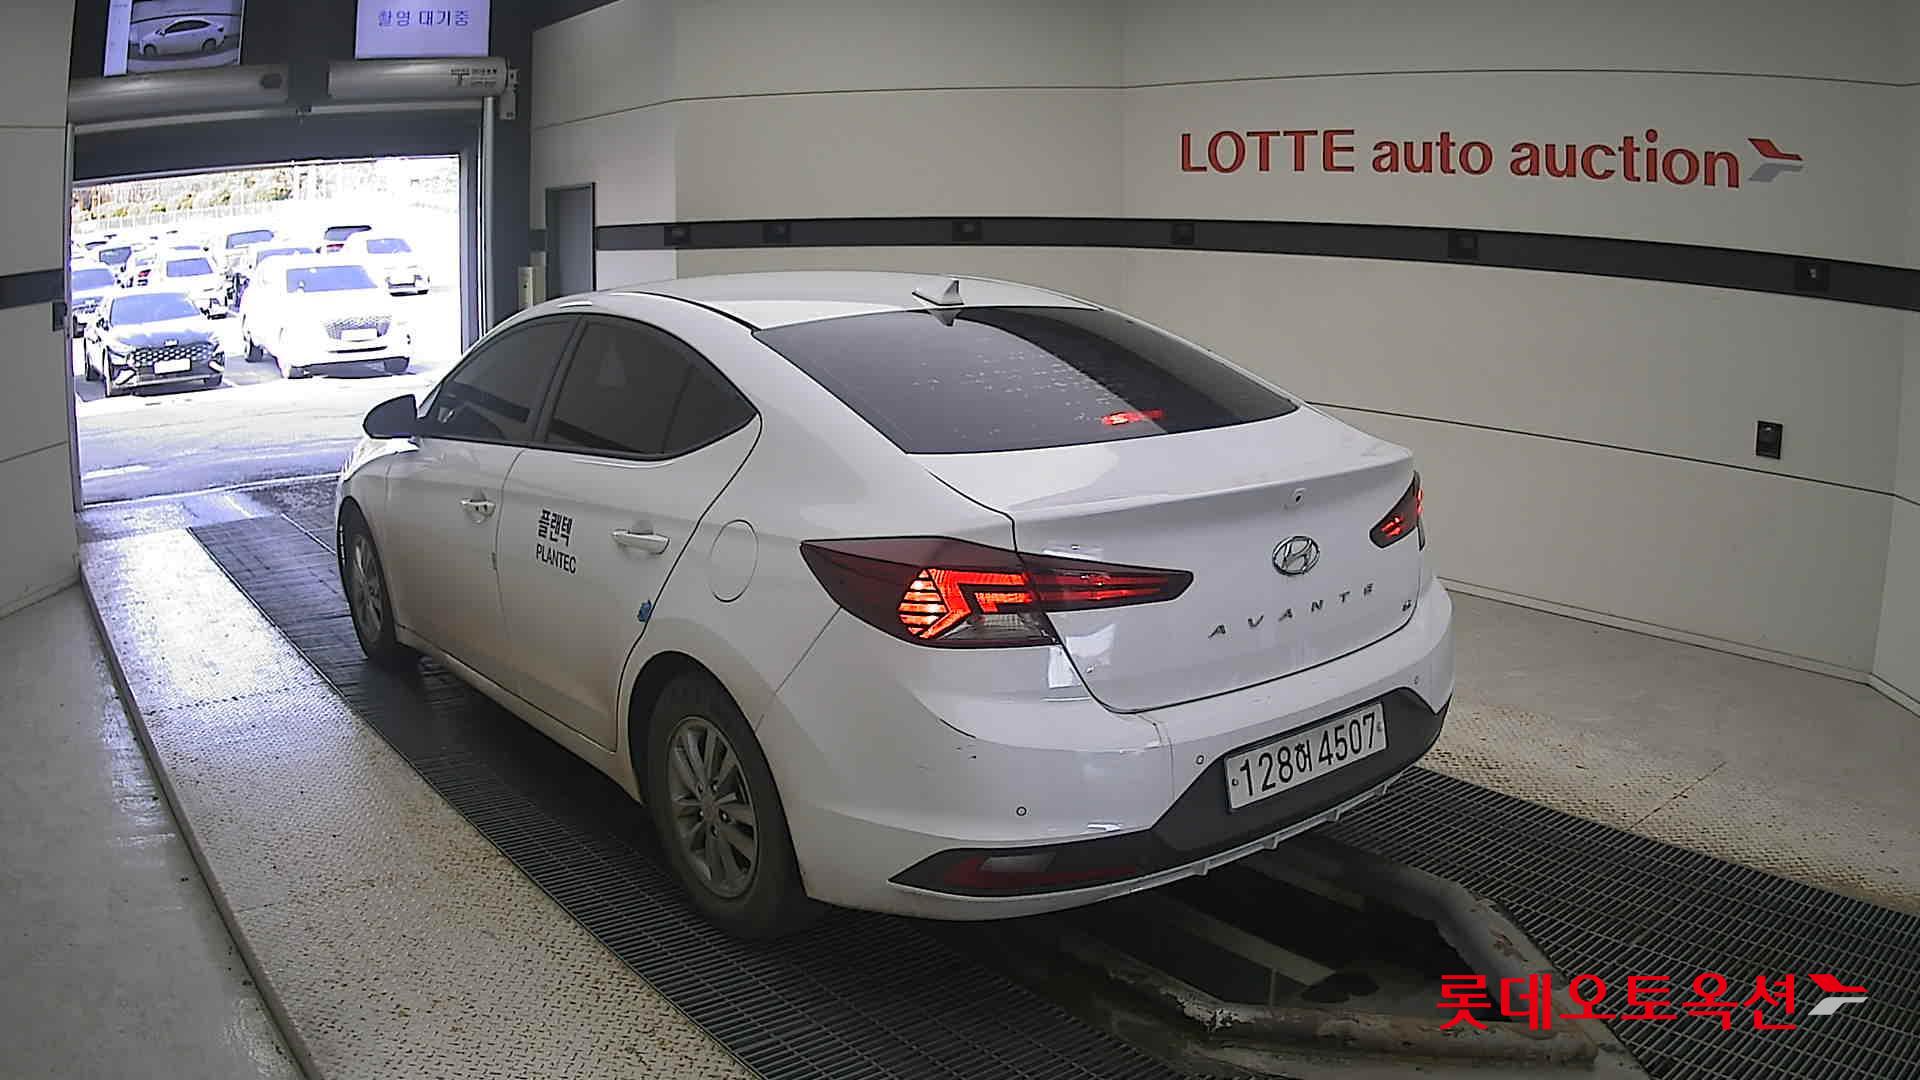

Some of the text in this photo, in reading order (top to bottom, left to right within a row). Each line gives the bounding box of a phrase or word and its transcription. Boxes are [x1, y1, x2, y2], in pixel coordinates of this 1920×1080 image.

[419, 9, 468, 27] 대기중
[1180, 128, 1740, 188] LOTTE auto auction
[538, 509, 573, 547] 플랜텍
[536, 543, 576, 574] PLANTEC
[1208, 583, 1374, 639] AVANTE
[1318, 712, 1375, 766] 4507
